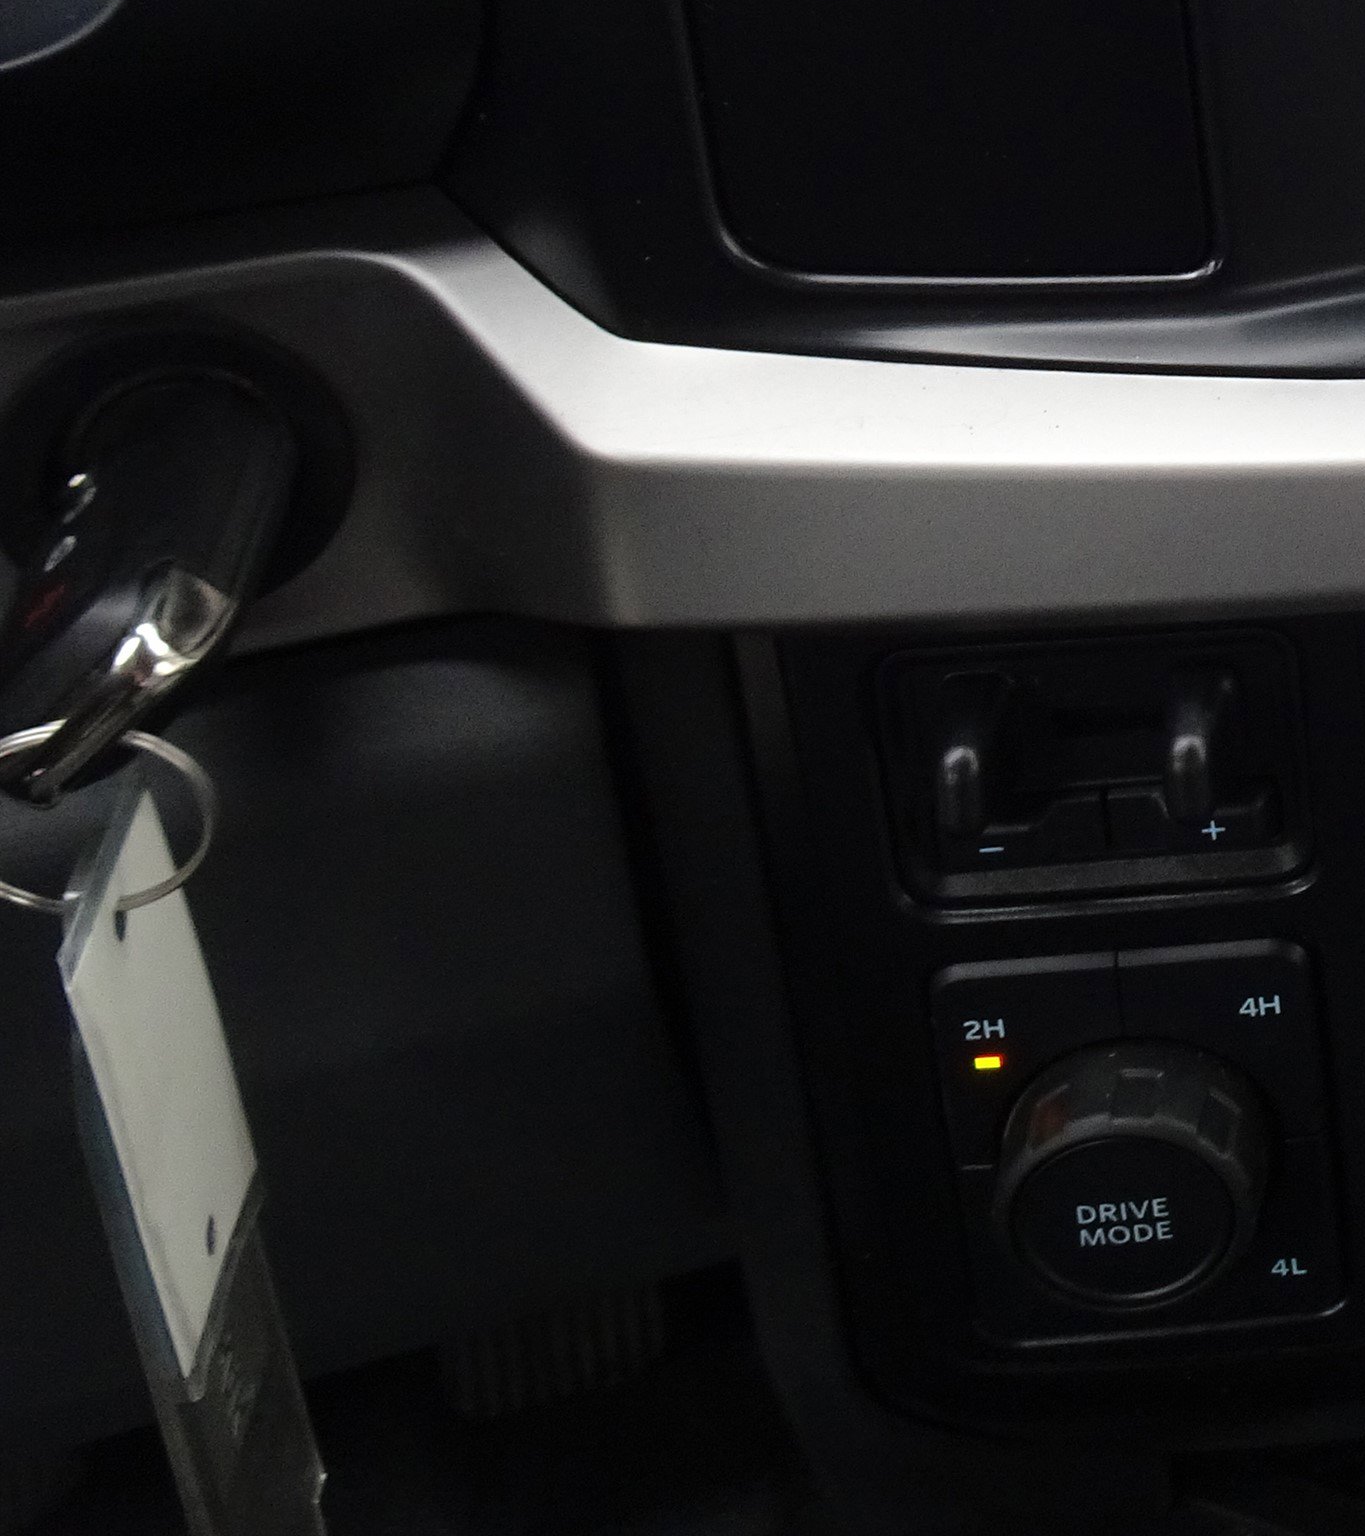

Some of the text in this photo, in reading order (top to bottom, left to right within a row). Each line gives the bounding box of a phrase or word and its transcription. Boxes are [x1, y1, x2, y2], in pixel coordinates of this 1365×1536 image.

[1238, 994, 1283, 1017] 4H
[963, 1018, 1006, 1041] 2H
[1076, 1196, 1170, 1225] DRIVE
[1079, 1220, 1174, 1249] MODE
[1271, 1257, 1308, 1277] 4L
